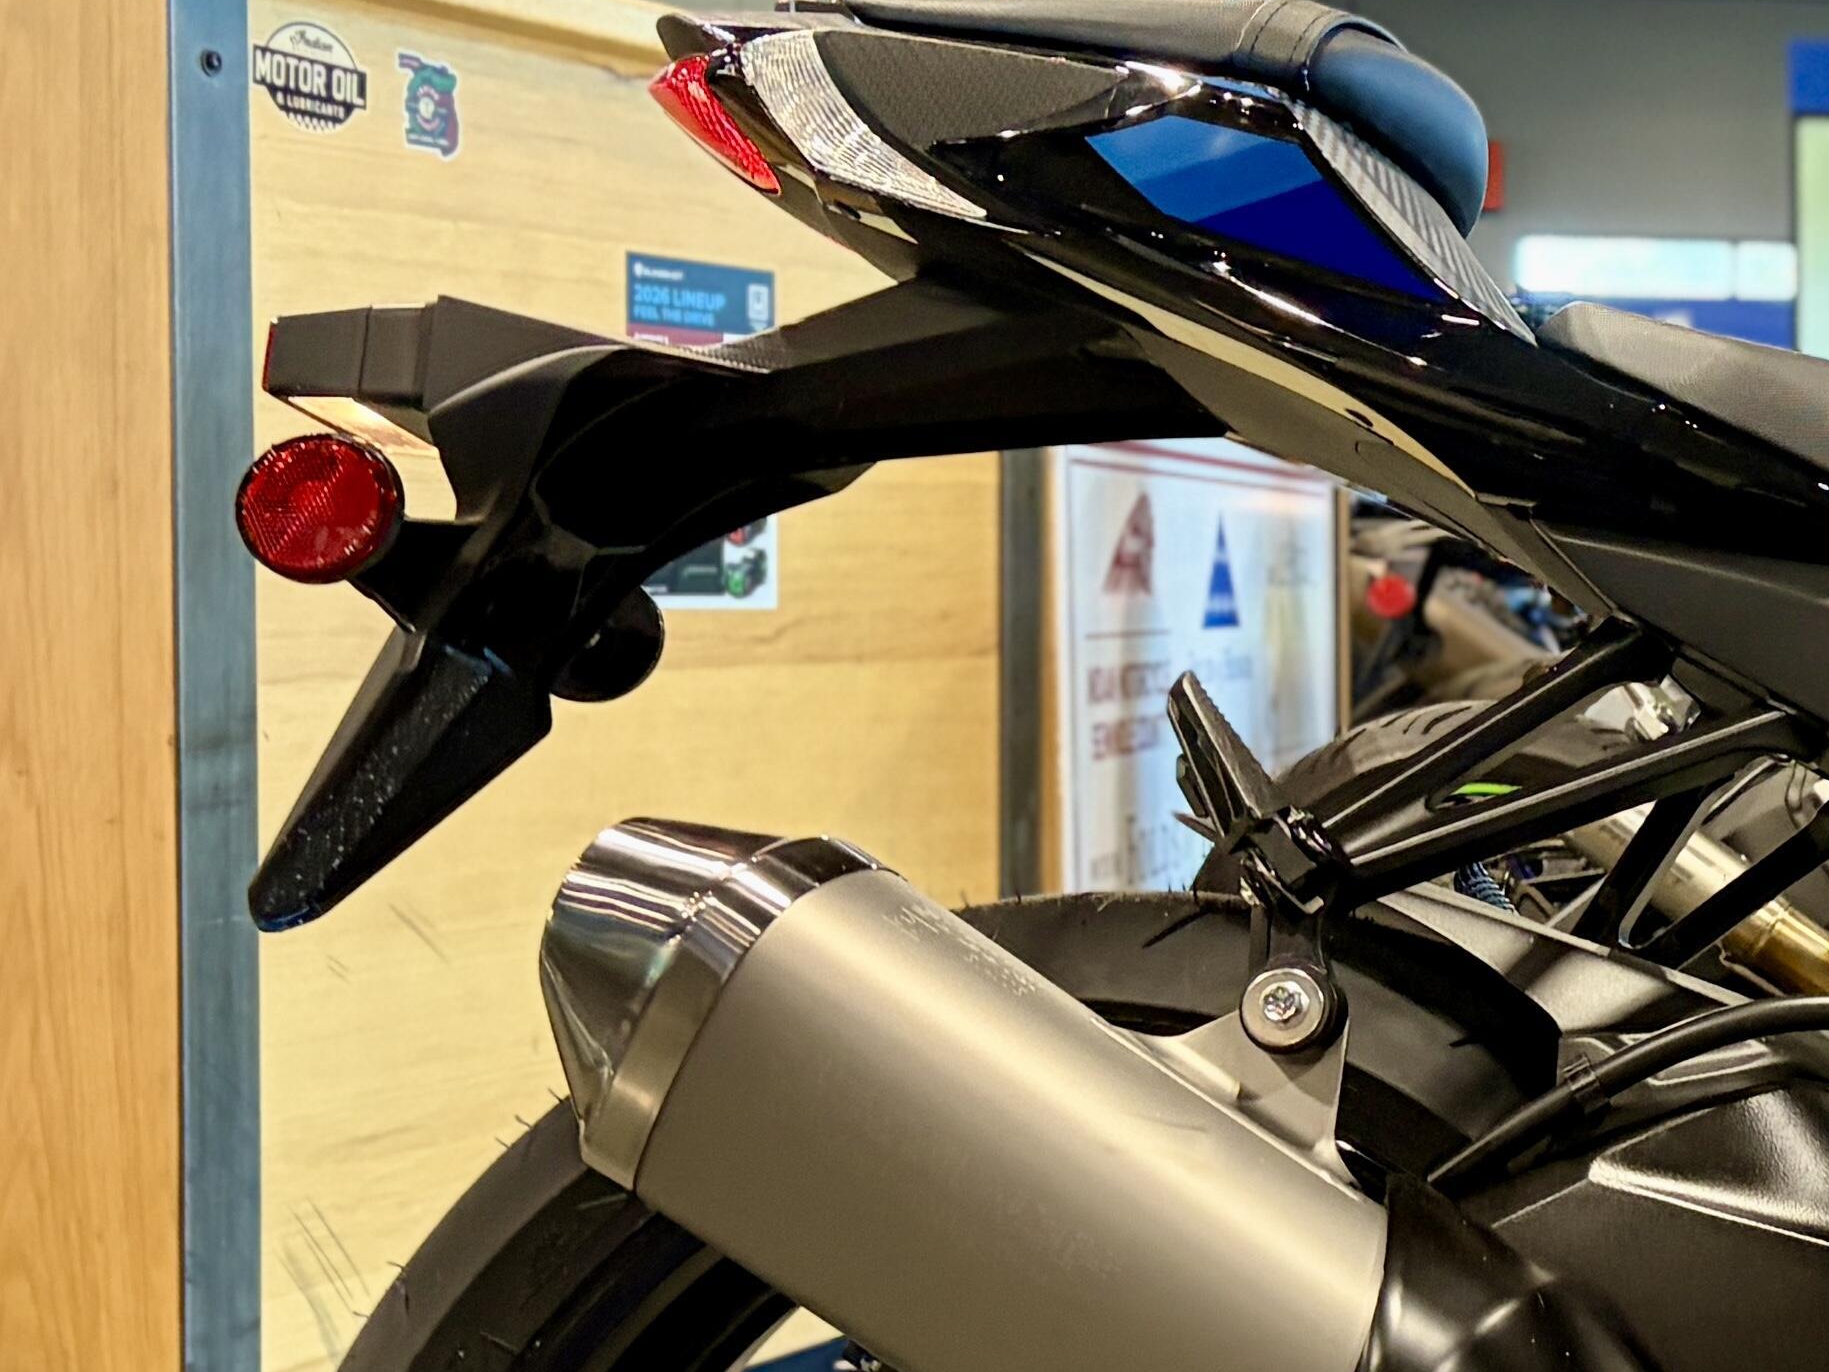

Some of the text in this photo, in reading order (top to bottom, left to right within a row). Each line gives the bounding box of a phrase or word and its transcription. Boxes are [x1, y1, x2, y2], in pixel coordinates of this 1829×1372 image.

[255, 49, 365, 105] MOTOR OIL
[672, 289, 727, 312] LINEUP
